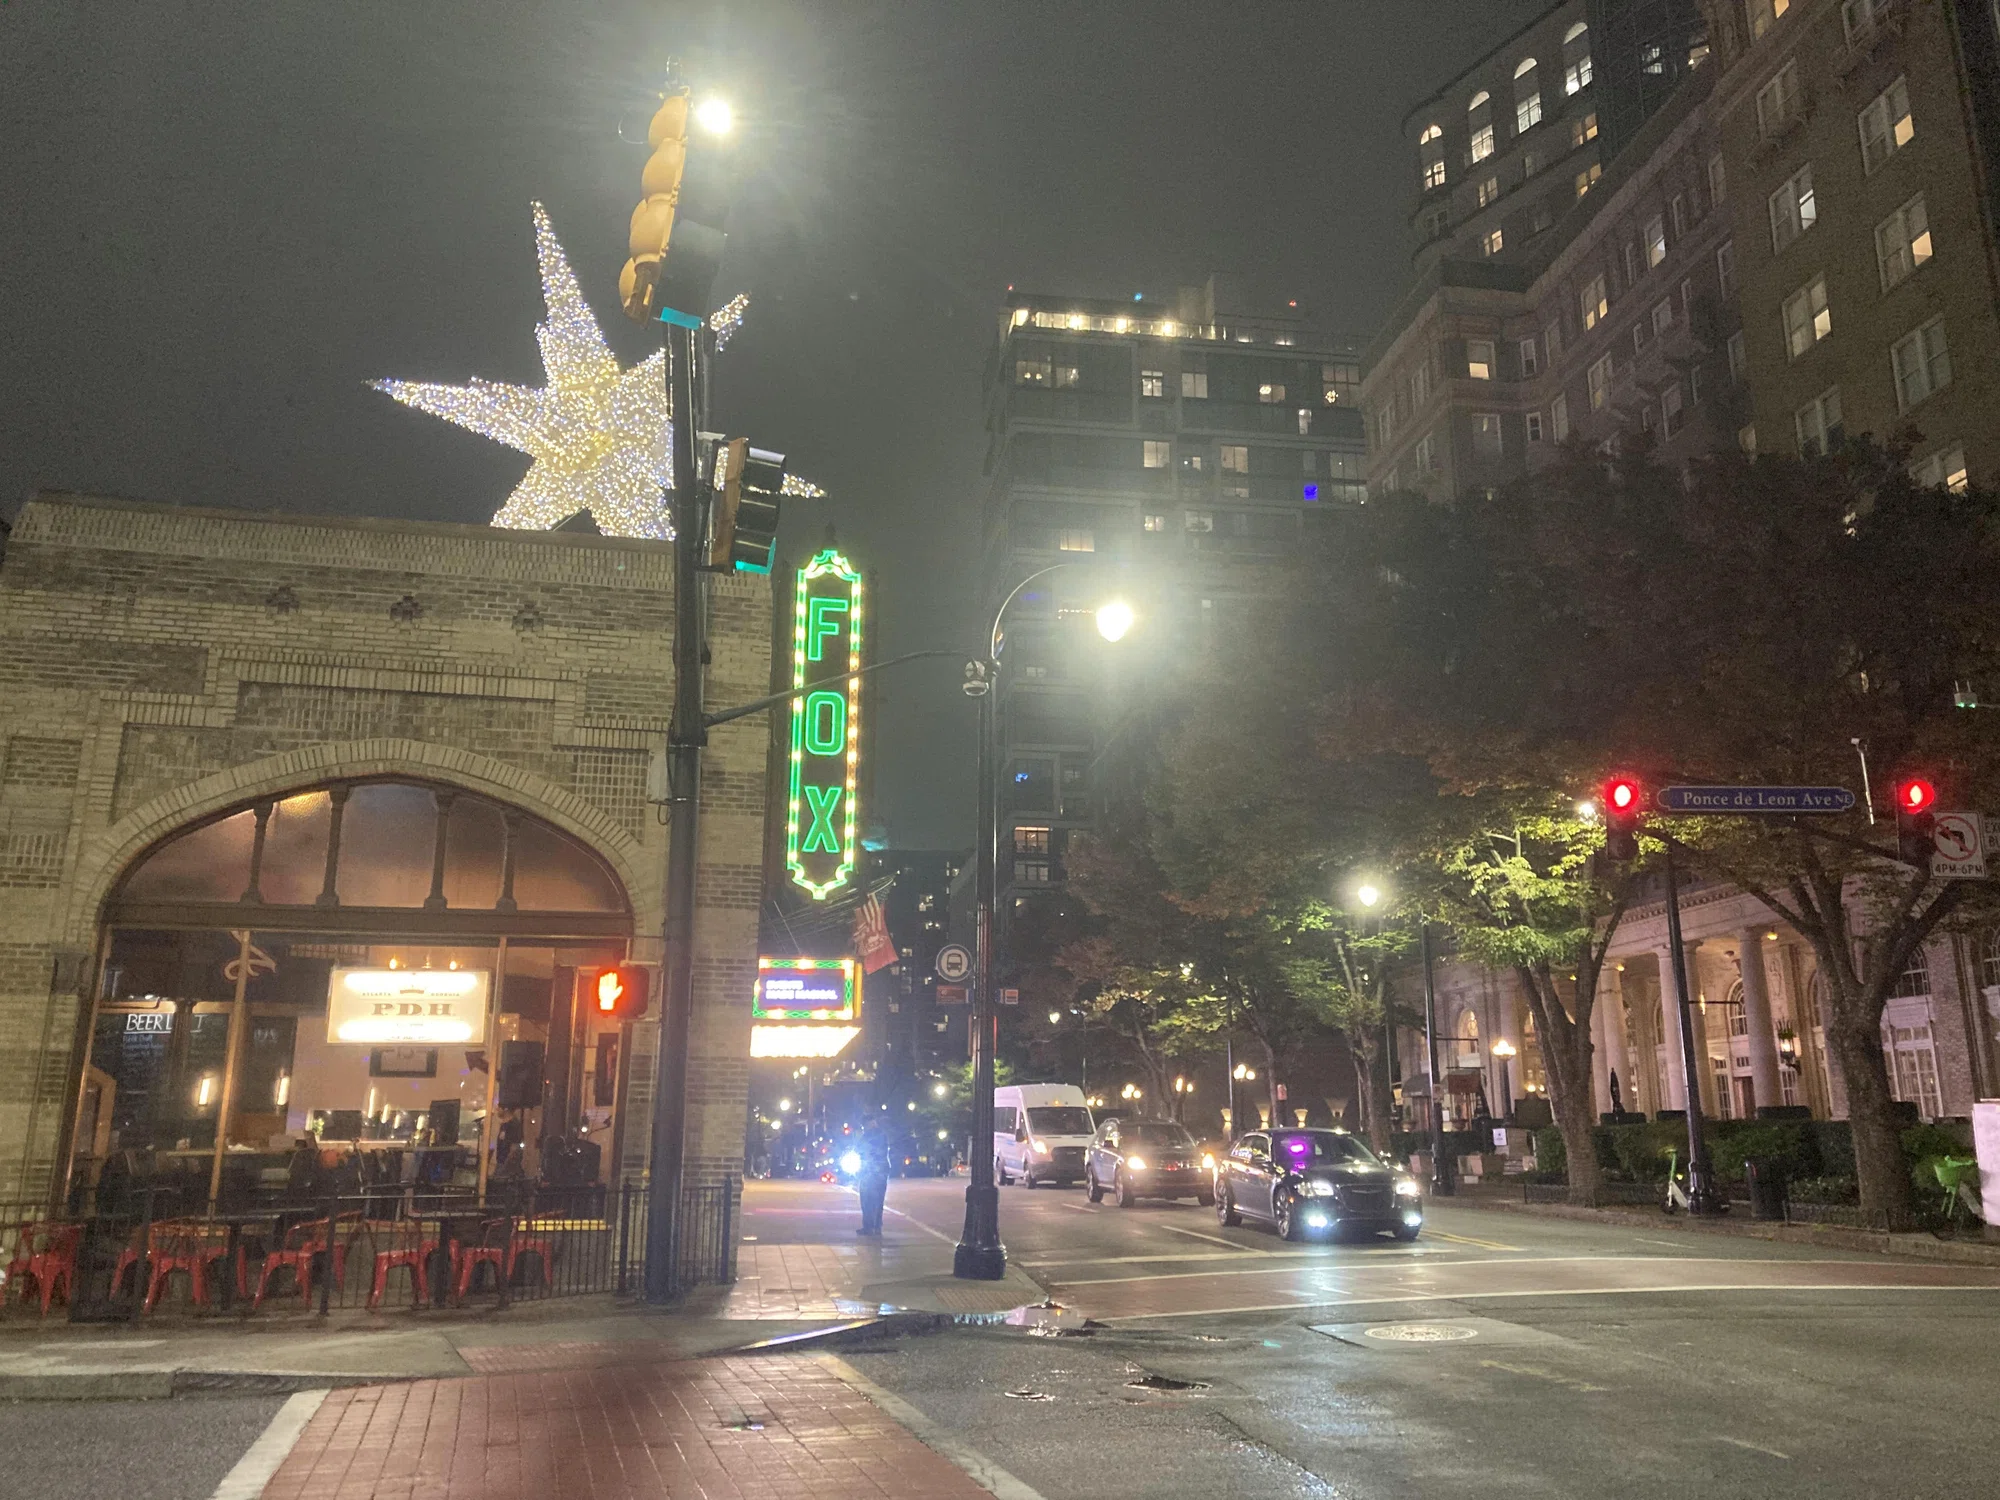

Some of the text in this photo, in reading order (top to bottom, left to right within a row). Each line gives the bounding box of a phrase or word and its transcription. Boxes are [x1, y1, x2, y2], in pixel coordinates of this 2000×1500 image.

[801, 597, 849, 853] FOX
[1683, 791, 1850, 806] Ponce de Leon Ave NE
[1935, 863, 1983, 875] 4PM-6PM
[126, 1013, 163, 1031] BEER
